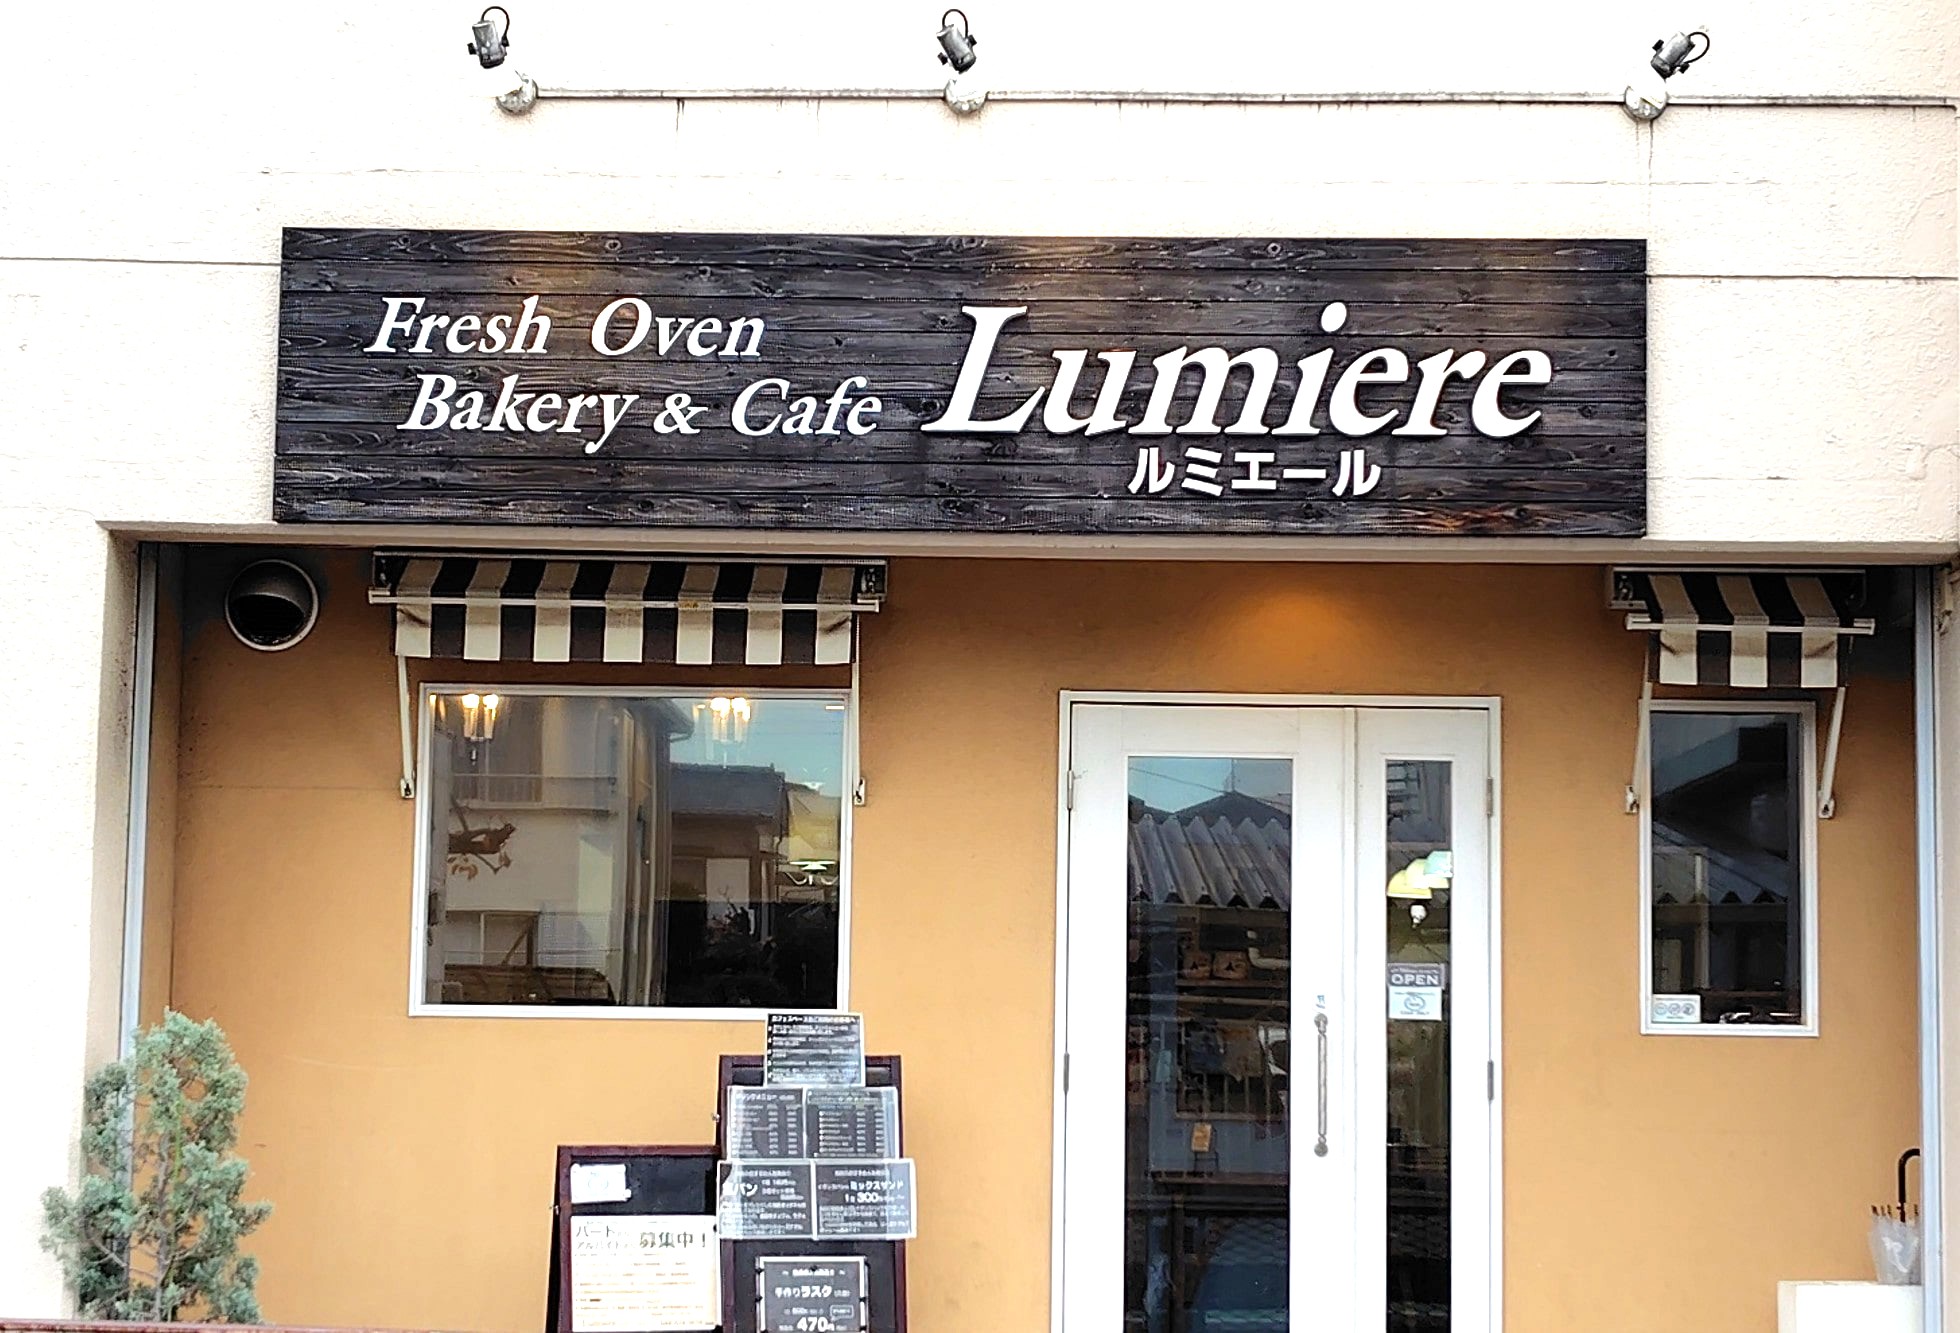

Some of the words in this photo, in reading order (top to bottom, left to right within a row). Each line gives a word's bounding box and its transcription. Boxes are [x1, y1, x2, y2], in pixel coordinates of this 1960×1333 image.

[364, 294, 551, 354] Fresh
[591, 297, 765, 357] Oven
[921, 302, 1552, 437] Lumiere
[397, 373, 640, 454] Bakery
[653, 393, 709, 434] &
[731, 376, 882, 436] Cafe
[1128, 447, 1381, 497] ルミエール
[1391, 973, 1439, 985] OPEN
